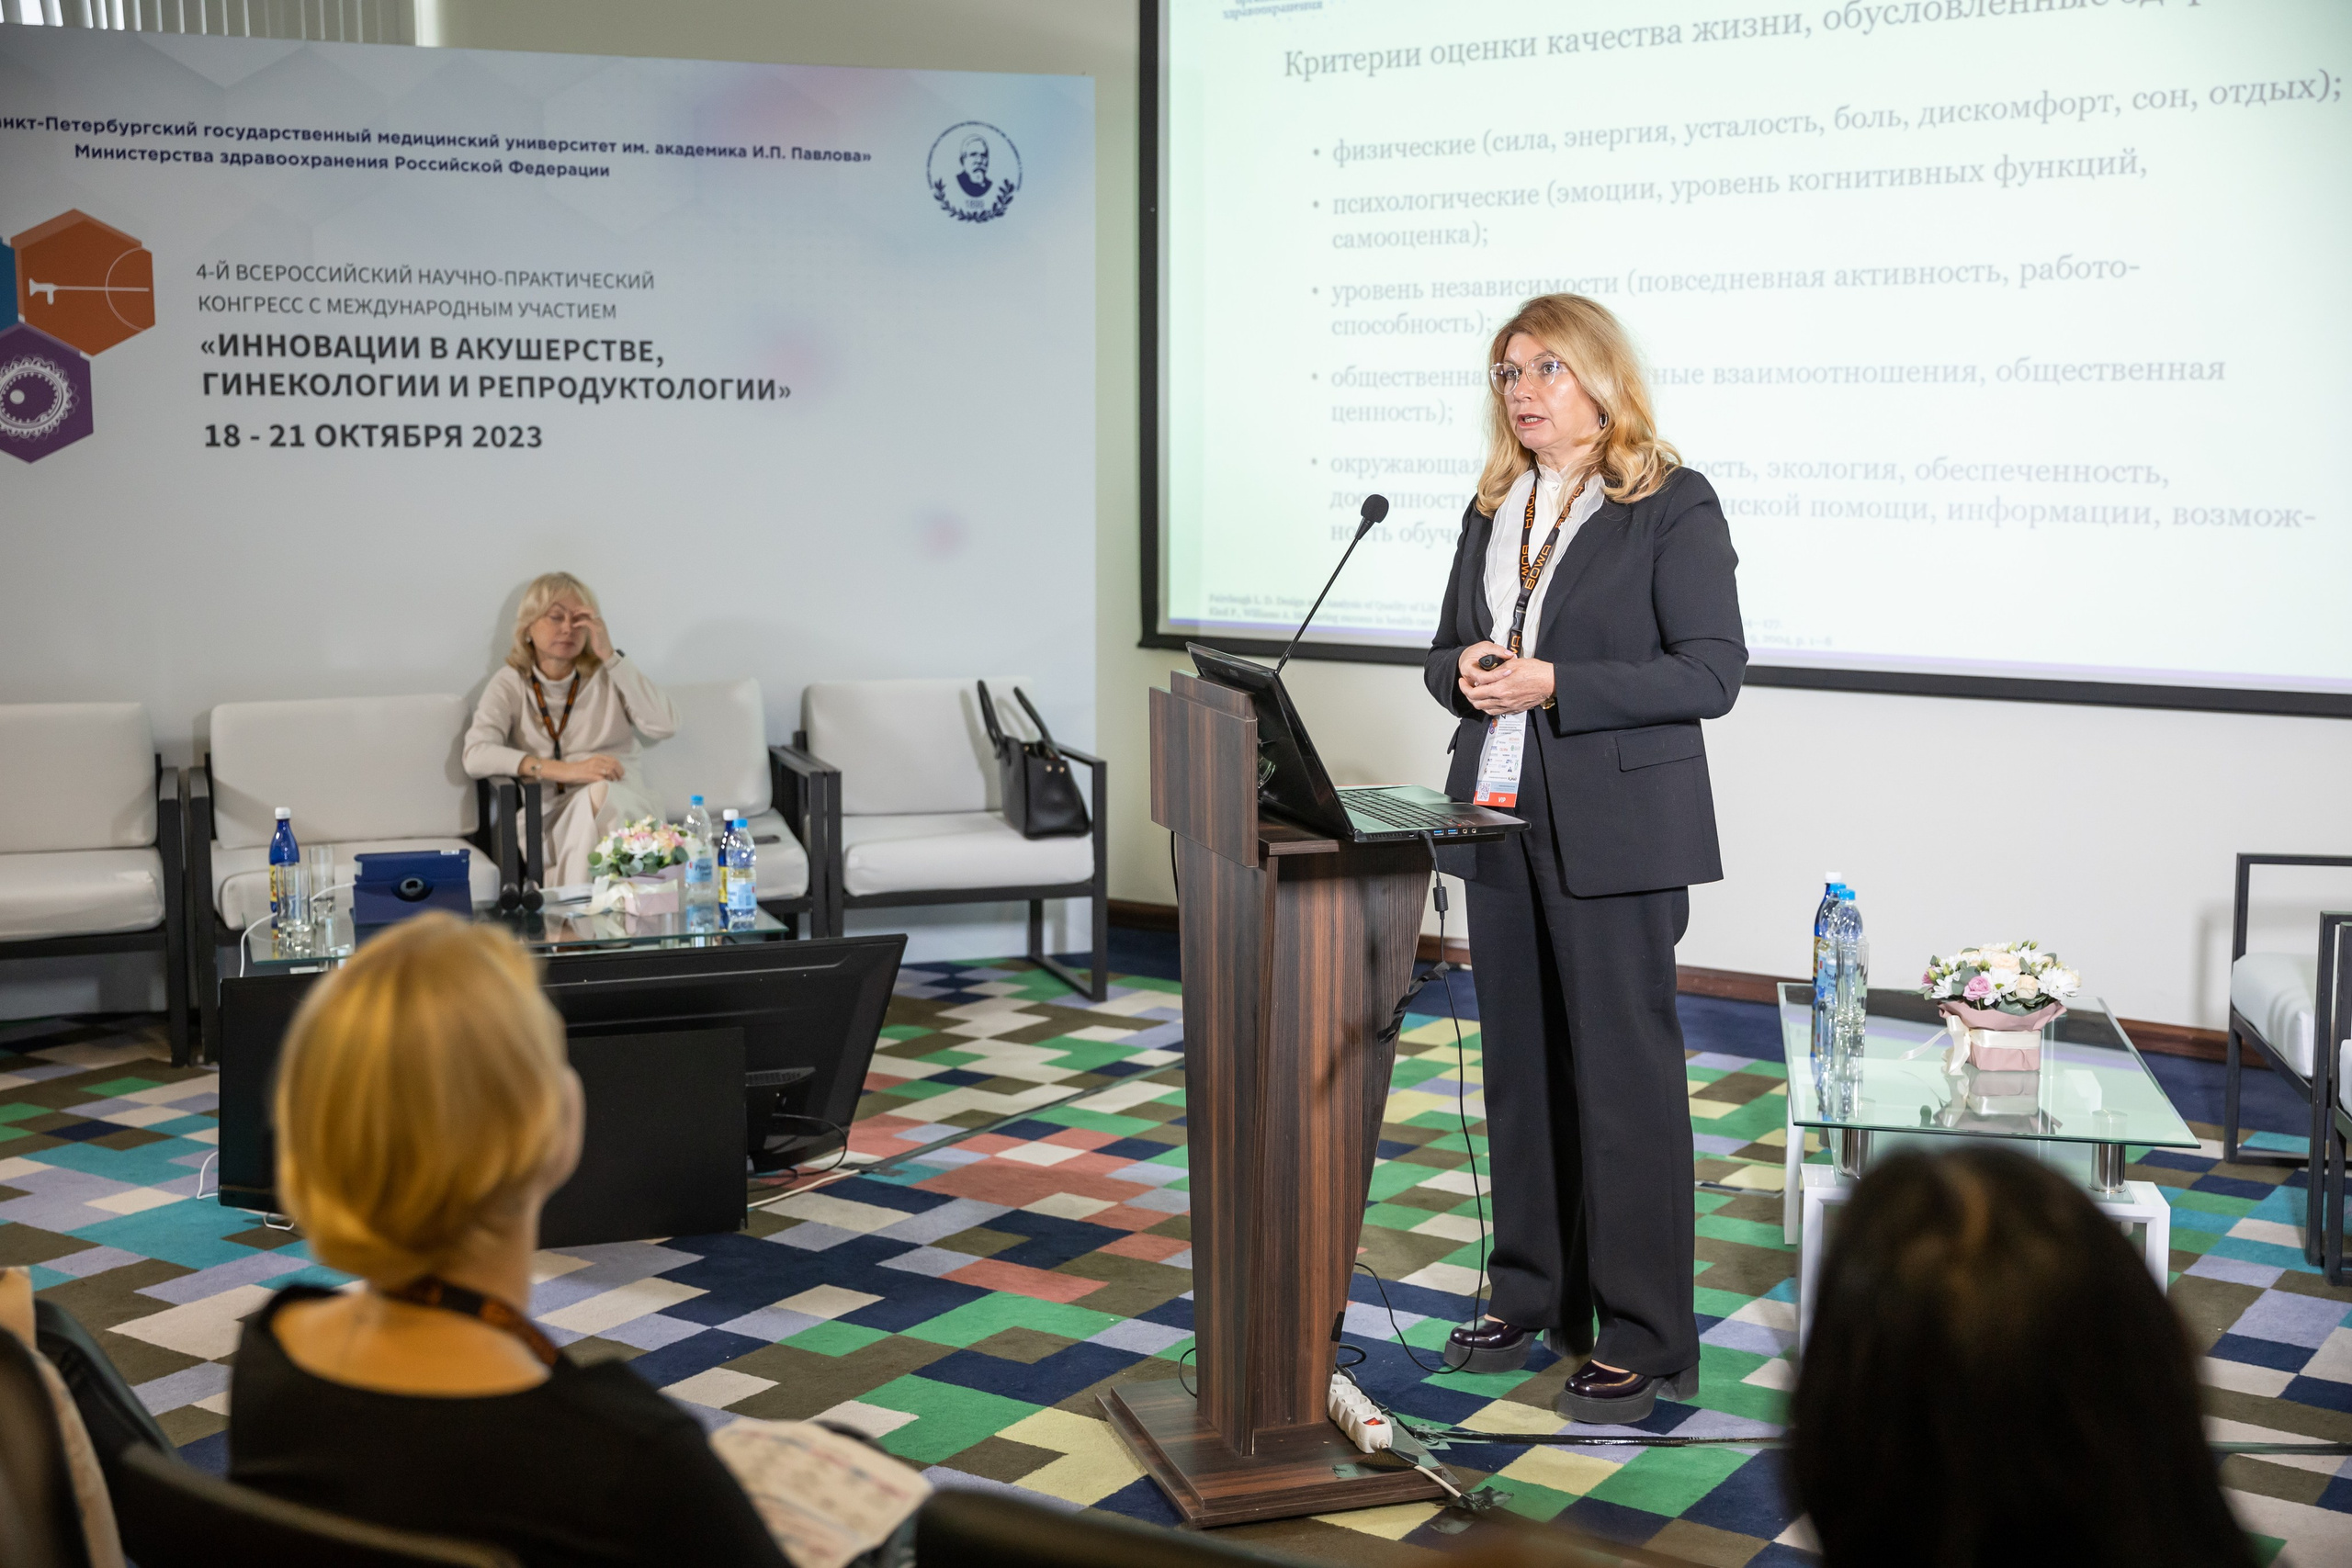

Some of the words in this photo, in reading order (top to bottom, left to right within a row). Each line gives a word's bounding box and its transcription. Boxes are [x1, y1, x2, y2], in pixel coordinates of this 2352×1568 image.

[1285, 47, 1421, 83] Критерии
[1430, 37, 1536, 66] оценки
[1547, 25, 1682, 55] качества
[1692, 13, 1812, 42] жизни,
[1823, 0, 2111, 36] обусловленн
[1332, 138, 1476, 168] физические
[1483, 129, 1556, 156] (сила,
[1564, 125, 1676, 152] энергия,
[1684, 116, 1825, 147] усталость,
[1834, 104, 1909, 130] боль,
[1917, 90, 2120, 129] дискомфорт,
[2132, 89, 2198, 112] сон,
[2210, 69, 2341, 107] отдых);
[75, 144, 213, 164] Министерства
[220, 152, 388, 169] здравоохранения
[395, 156, 503, 173] Российской
[509, 161, 609, 177] Федерации
[204, 126, 371, 142] государственный
[378, 133, 499, 148] медицинский
[505, 138, 616, 153] университет
[623, 143, 649, 153] им.
[655, 144, 747, 158] академика
[752, 146, 786, 159] И.П.
[792, 147, 871, 162] Павлова»
[1333, 188, 1540, 215] психологические
[1547, 179, 1662, 209] (эмоции,
[1670, 175, 1781, 204] уровень
[1789, 164, 1984, 192] когнитивных
[1994, 147, 2146, 188] функций,
[1332, 220, 1488, 249] самооценка);
[197, 264, 229, 280] 4-Й
[236, 264, 412, 284] ВСЕРОССИЙСКИЙ
[419, 269, 654, 289] НАУЧНО-ПРАКТИЧЕСКИЙ
[1331, 283, 1424, 308] уровень
[1430, 276, 1620, 298] независимости
[1627, 268, 1826, 296] (повседневная
[1834, 265, 2008, 287] активность,
[2019, 254, 2140, 288] работо-
[198, 295, 303, 313] КОНГРЕСС
[309, 297, 321, 314] С
[327, 298, 513, 320] МЕЖДУНАРОДНЫМ
[518, 302, 616, 319] УЧАСТИЕМ
[1331, 310, 1493, 337] способность);
[201, 333, 419, 365] «ИННОВАЦИИ
[431, 337, 448, 359] В
[457, 338, 663, 367] АКУШЕРСТВЕ,
[203, 373, 438, 397] ГИНЕКОЛОГИИ
[450, 376, 468, 397] И
[480, 376, 790, 404] РЕПРОДУКТОЛОГИИ»
[1331, 365, 1487, 389] общественна
[1652, 367, 1704, 385] ные
[1713, 365, 1985, 387] взаимоотношения,
[1996, 356, 2225, 386] общественная
[1332, 399, 1453, 425] ценность);
[206, 424, 241, 447] 18
[270, 424, 305, 447] 21
[315, 424, 462, 447] ОКТЯБРЯ
[473, 425, 542, 448] 2023
[1330, 457, 1483, 479] окружающая
[1689, 460, 1758, 482] ость,
[1768, 462, 1905, 485] экология,
[1915, 456, 2169, 489] обеспеченность,
[1811, 500, 1936, 525] помощи,
[1948, 495, 2160, 529] информации,
[2173, 507, 2316, 528] возмож-
[1521, 545, 1531, 581] BOW
[1525, 544, 1552, 591] BOWA
